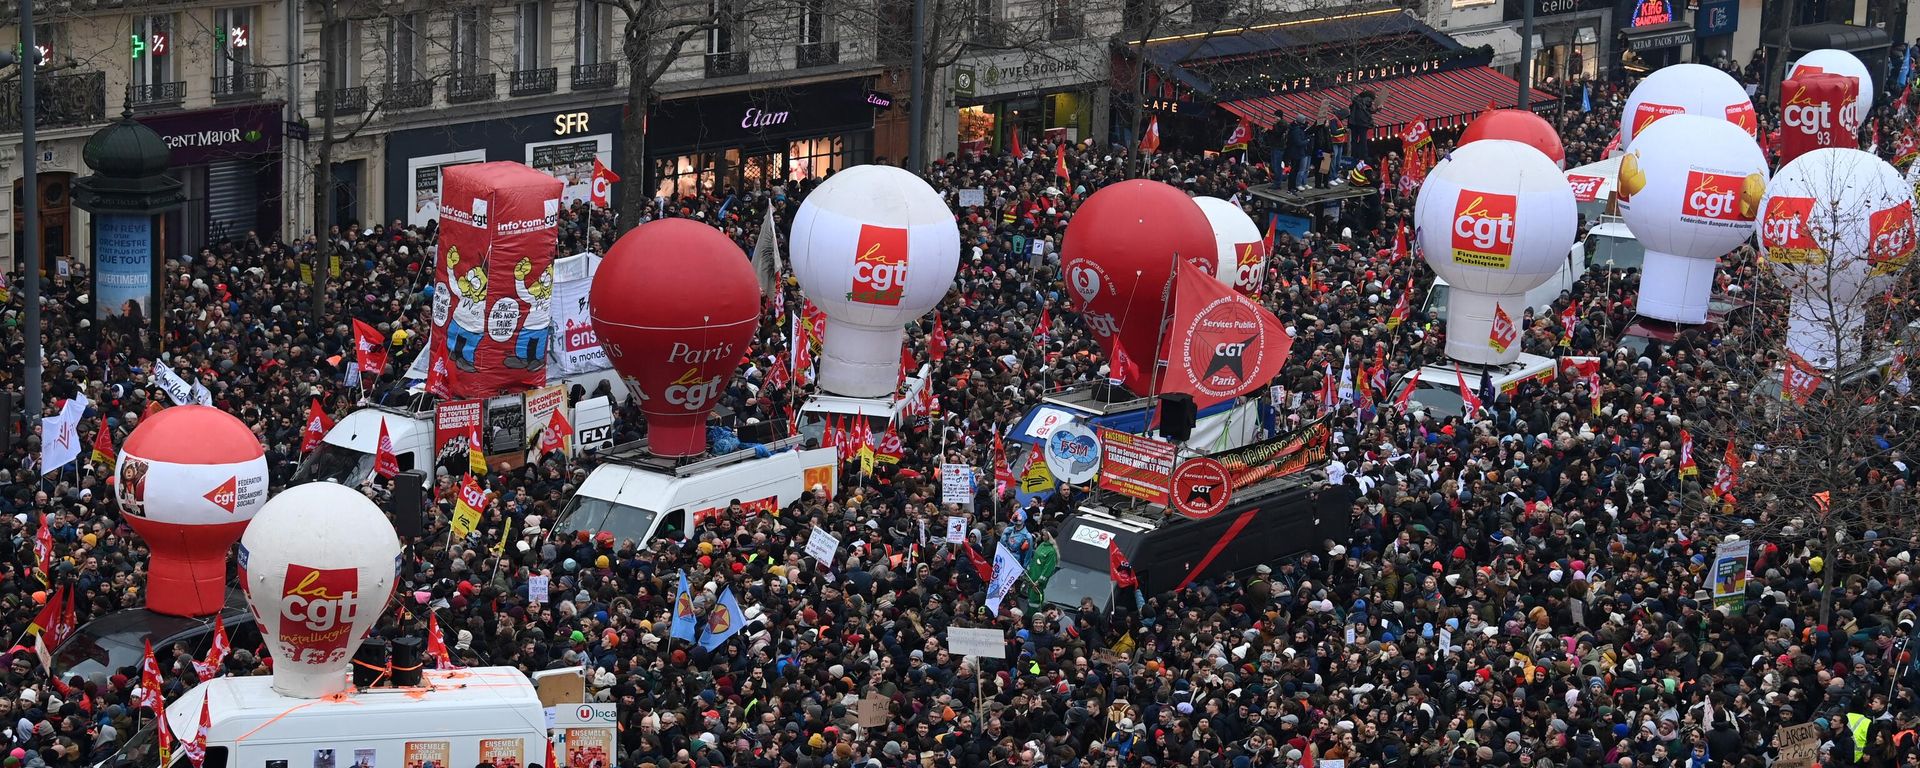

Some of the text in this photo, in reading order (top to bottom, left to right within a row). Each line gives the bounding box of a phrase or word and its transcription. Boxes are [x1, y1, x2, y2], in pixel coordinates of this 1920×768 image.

[1635, 13, 1669, 27] SANDWICH
[153, 35, 164, 52] 7/7
[232, 27, 247, 47] 24/24
[1633, 34, 1691, 50] KEBAB TACOS PIZZA
[1002, 61, 1078, 78] YVES ROCHER
[867, 94, 890, 107] Etam
[555, 112, 589, 135] SFR
[742, 107, 789, 129] Etam
[1784, 101, 1831, 135] cgt
[1817, 131, 1830, 145] 93
[1694, 176, 1722, 194] la
[1459, 196, 1494, 220] la
[1690, 189, 1735, 218] cgt
[1455, 213, 1513, 249] cgt
[1764, 213, 1801, 247] cgt
[100, 254, 147, 265] QUE TOUT
[858, 243, 893, 265] la
[1239, 244, 1260, 265] la
[1455, 256, 1505, 268] Publiques
[1457, 250, 1504, 262] Finances
[852, 260, 907, 291] cgt
[1236, 256, 1265, 291] cgt
[1081, 313, 1119, 337] cgt
[1203, 319, 1256, 329] Services Publics
[571, 330, 597, 347] ens
[570, 351, 606, 364] le monde
[667, 341, 733, 364] Paris
[1215, 342, 1245, 357] CGT
[671, 367, 708, 385] la
[1211, 375, 1236, 387] Paris
[528, 388, 563, 407] DÉCONFINE
[664, 377, 722, 410] cgt
[439, 402, 481, 412] TRAVAILLEURS
[471, 408, 480, 416] LES
[529, 407, 537, 415] TA
[439, 414, 480, 424] ENTREPRES
[439, 420, 480, 430] UNISSEZ-VUS
[582, 427, 611, 443] FLY
[1060, 440, 1088, 457] FSM
[806, 468, 830, 484] 60
[1156, 465, 1169, 476] PLUS
[463, 486, 487, 507] cgt
[1192, 485, 1211, 493] CGT
[214, 492, 234, 505] cgt
[237, 499, 256, 508] SOCIAUX
[287, 570, 340, 600] la
[280, 591, 358, 632] cgt
[280, 625, 351, 644] métallurgie
[581, 710, 589, 718] U
[571, 729, 606, 737] ENSEMBLE
[1778, 724, 1813, 748] L'ARGENT
[410, 743, 445, 751] ENSEMBLE
[571, 739, 604, 747] RETRAITE
[410, 753, 444, 761] RETRAITE
[485, 750, 517, 758] RETRAITE
